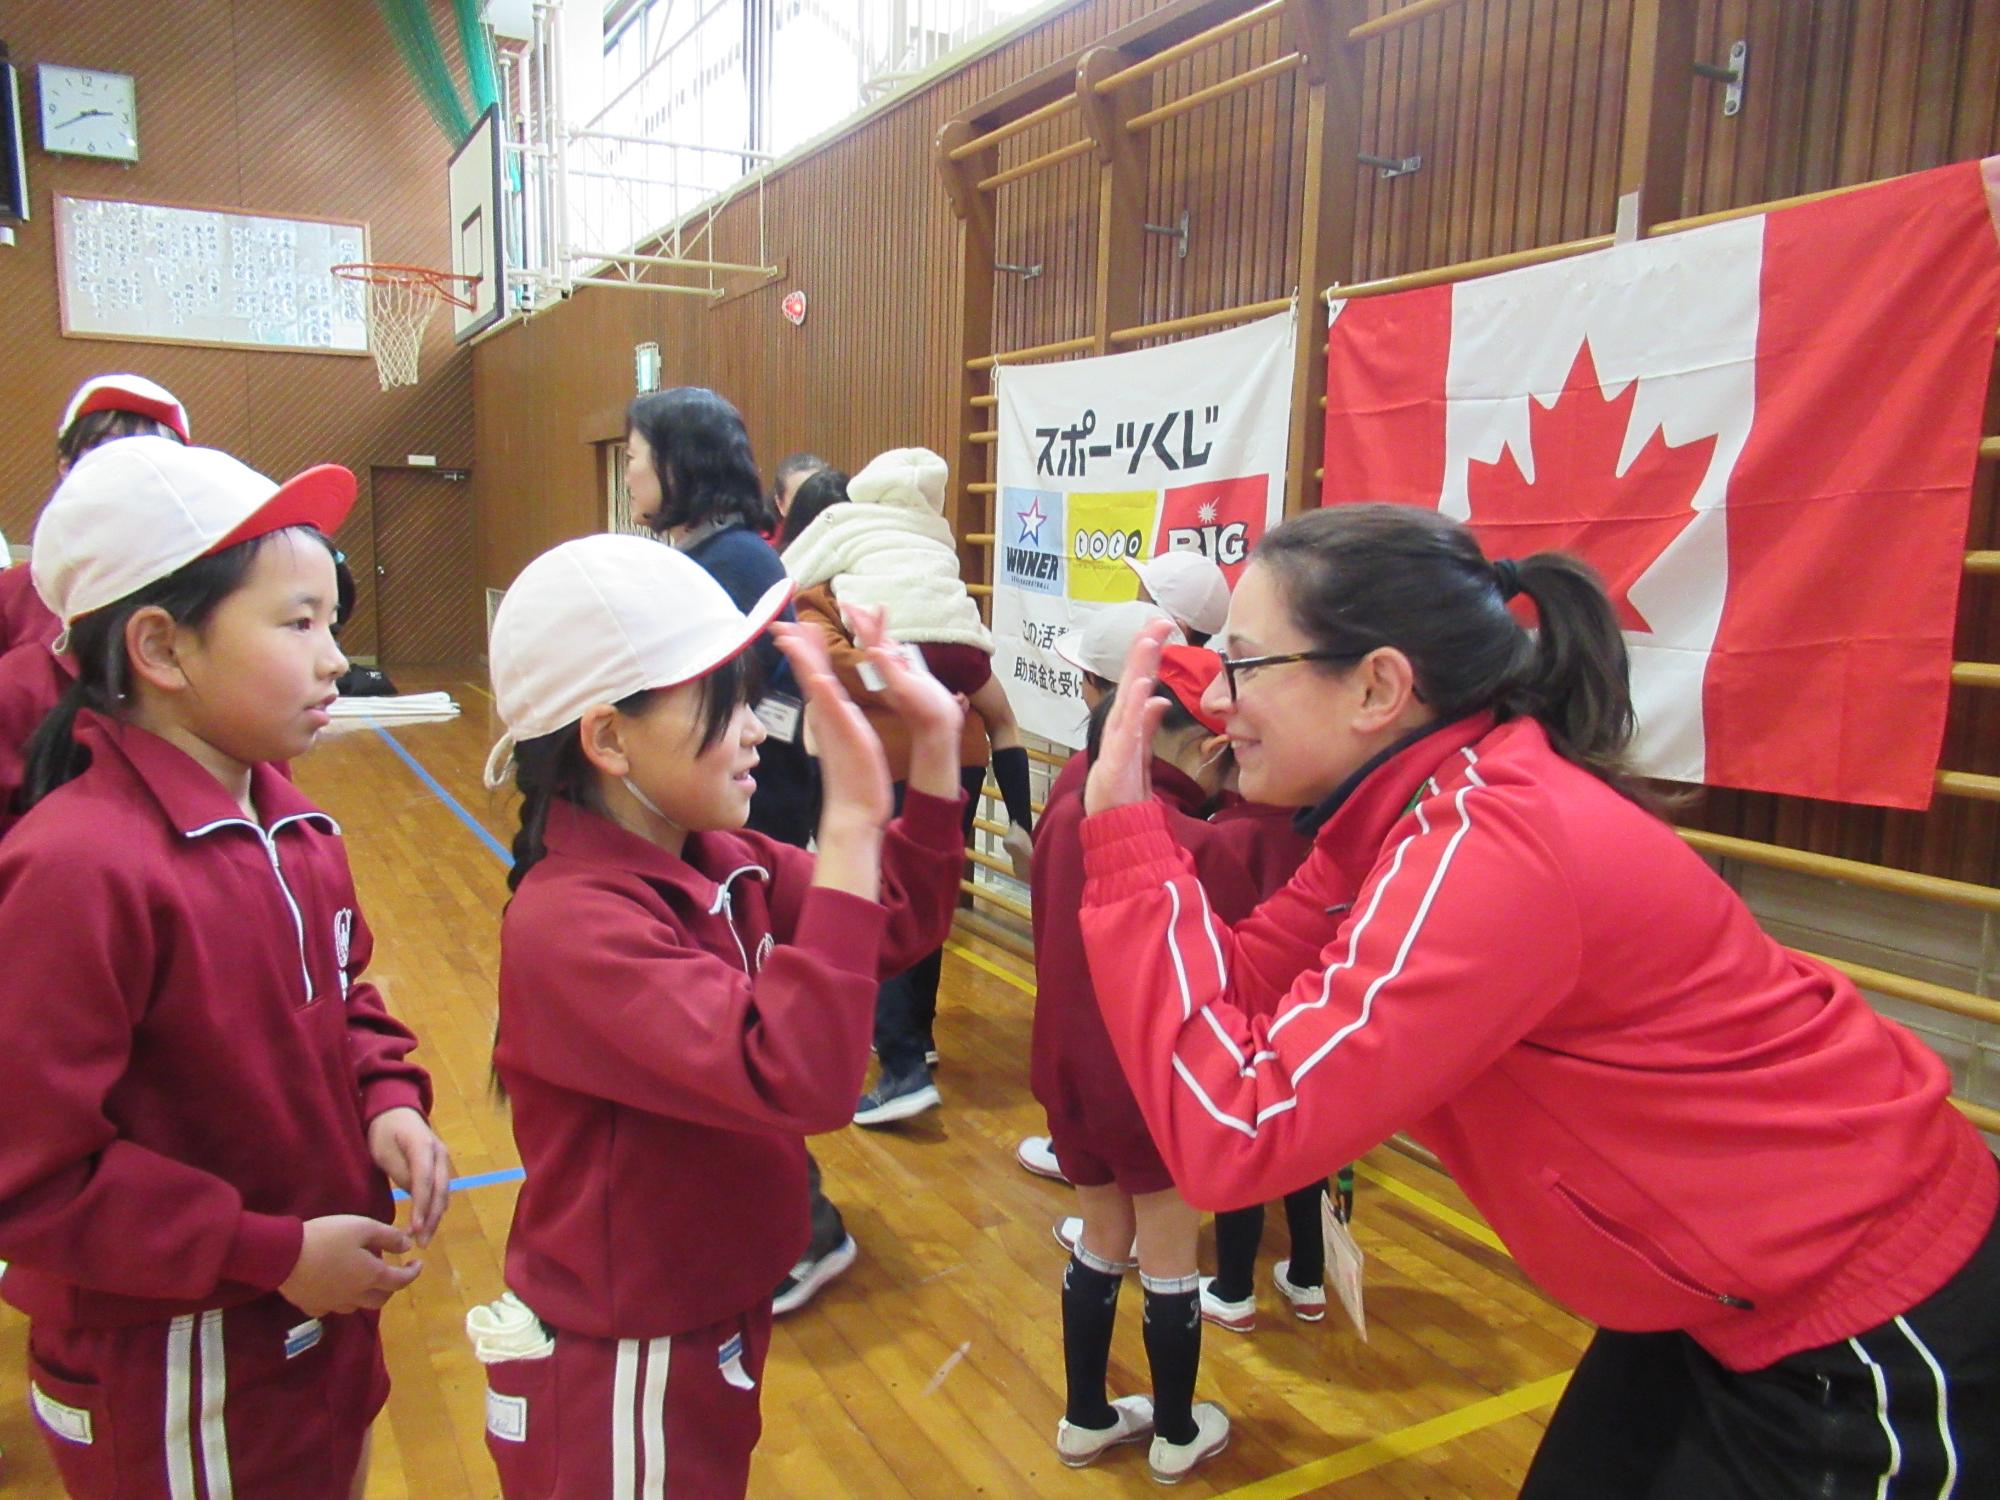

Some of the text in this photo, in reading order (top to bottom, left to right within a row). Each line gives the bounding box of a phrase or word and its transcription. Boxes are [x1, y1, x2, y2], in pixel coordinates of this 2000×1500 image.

[80, 74, 93, 87] 12
[48, 103, 57, 114] 9
[122, 112, 129, 124] 3
[87, 142, 96, 152] 6
[1036, 405, 1219, 477] スポーツくじ
[1076, 529, 1142, 560] toto
